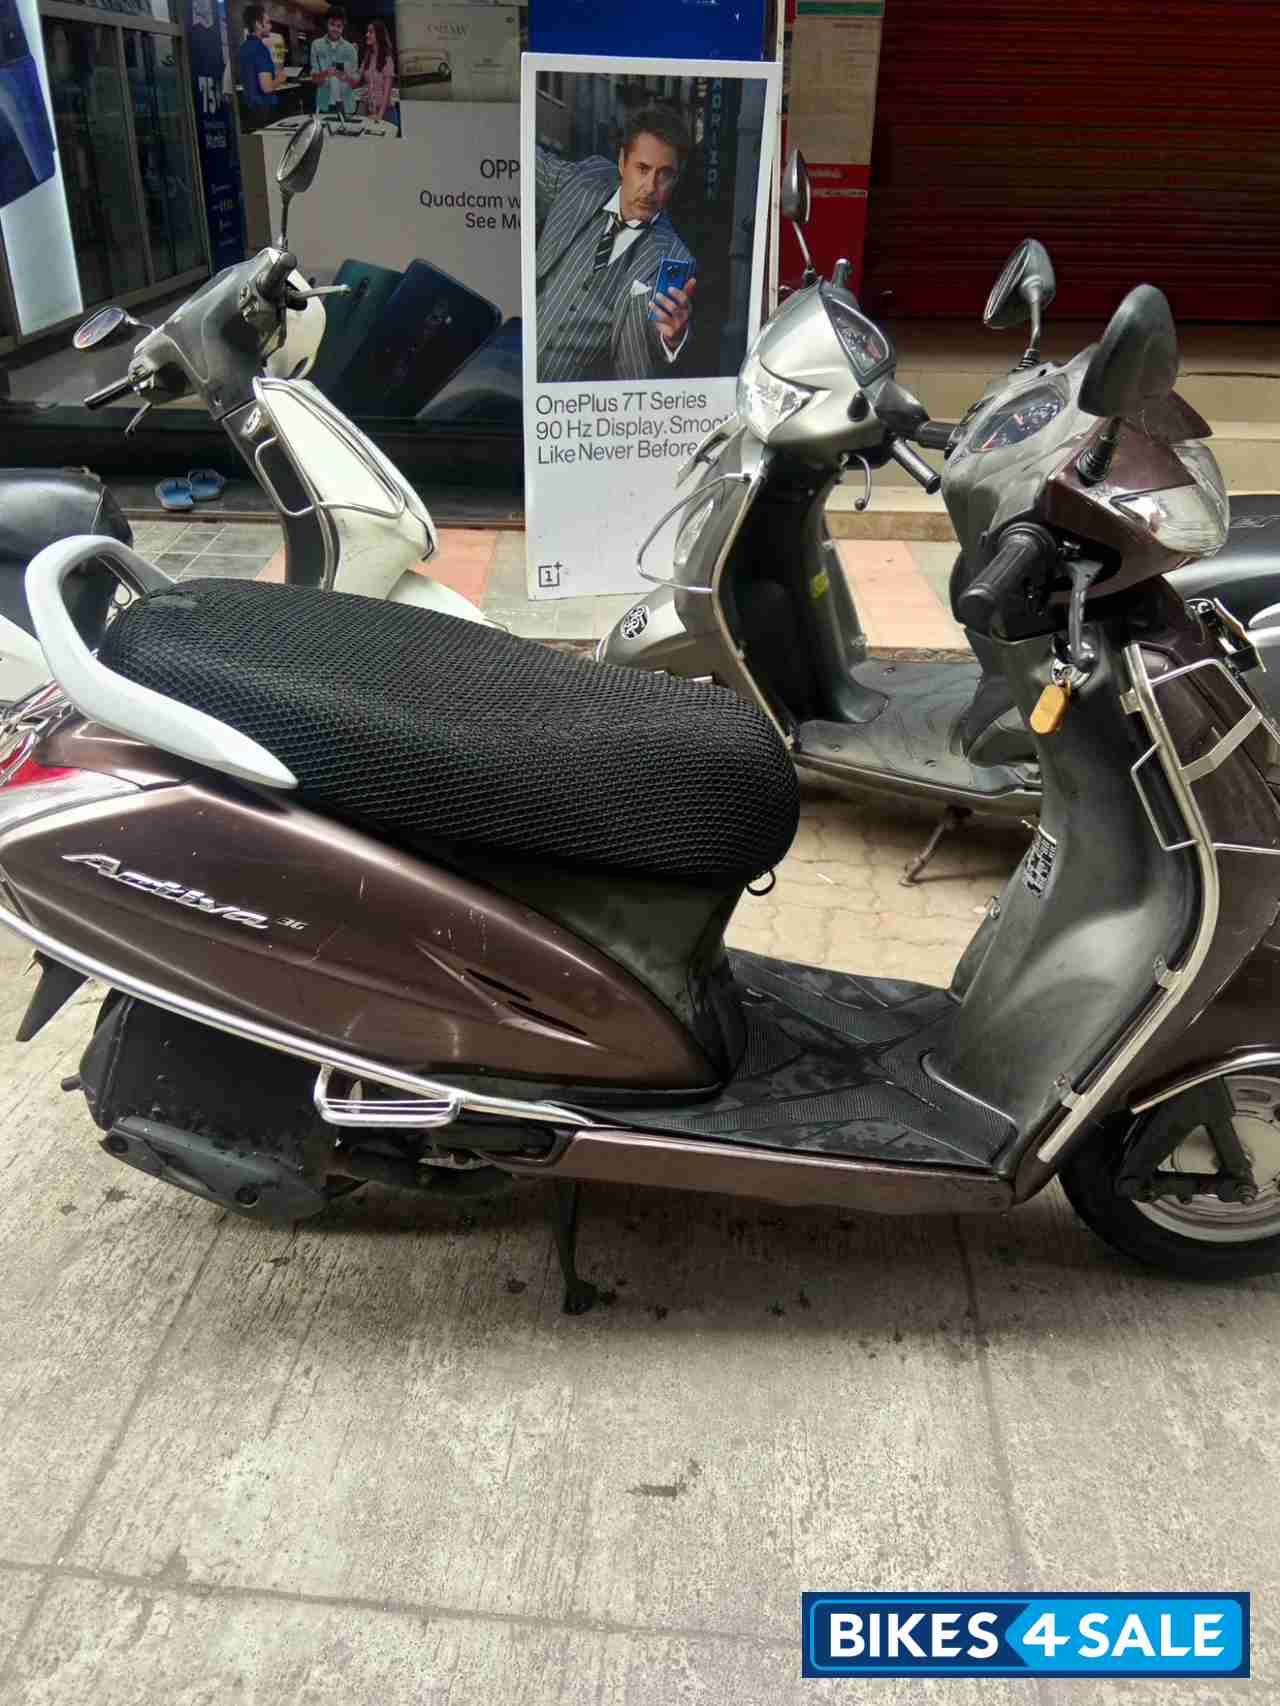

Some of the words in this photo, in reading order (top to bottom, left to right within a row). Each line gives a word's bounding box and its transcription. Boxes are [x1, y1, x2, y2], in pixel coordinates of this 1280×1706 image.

[420, 190, 503, 208] Quadcam
[465, 212, 497, 229] See
[502, 213, 521, 230] M
[536, 393, 618, 415] OnePlus
[622, 392, 648, 411] 7T
[650, 391, 707, 409] Series
[536, 421, 562, 440] 90
[567, 420, 592, 438] Hz
[597, 418, 667, 439] Display.
[538, 445, 576, 464] Like
[579, 443, 633, 461] Never
[638, 439, 698, 458] Before
[61, 855, 268, 929] Activa
